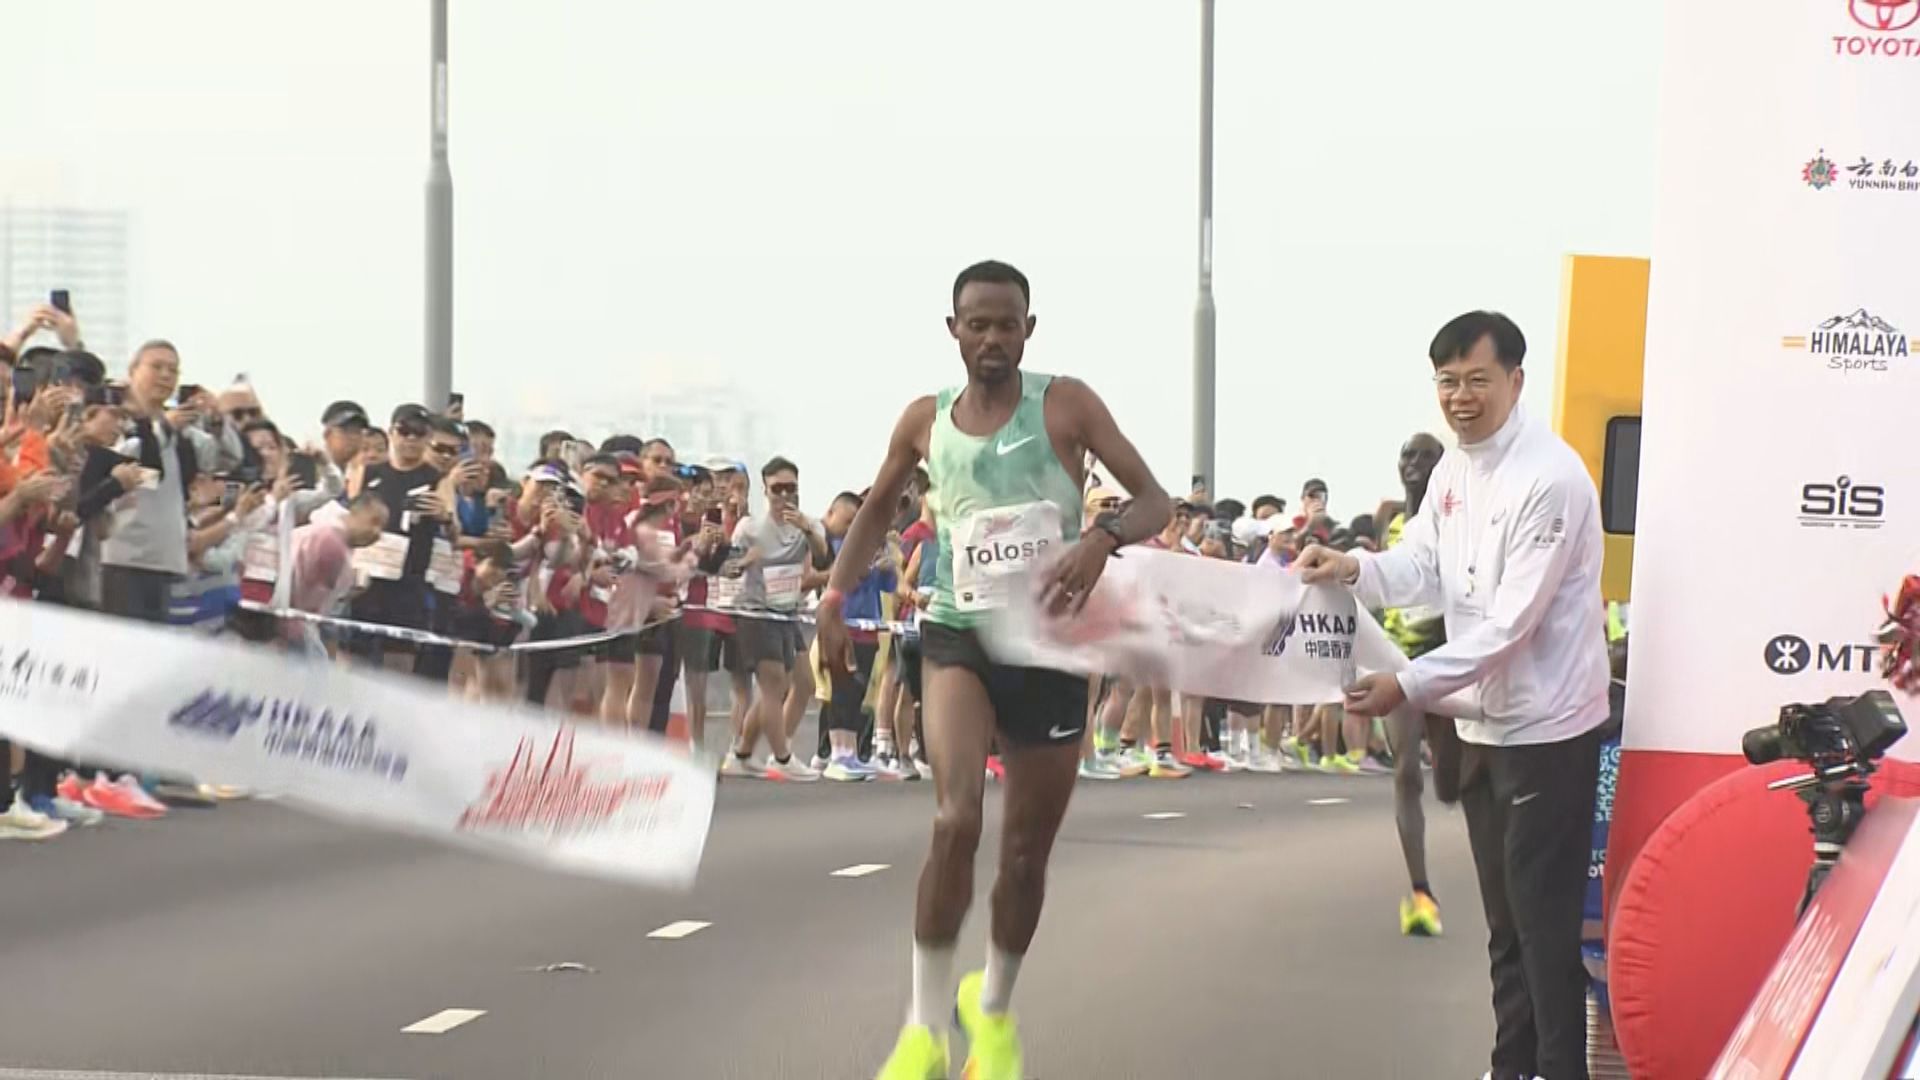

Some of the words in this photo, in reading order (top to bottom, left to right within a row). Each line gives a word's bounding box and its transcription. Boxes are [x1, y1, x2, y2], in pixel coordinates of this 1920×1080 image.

[1811, 331, 1908, 357] HIMALAYA
[1827, 356, 1888, 375] Sports
[1817, 643, 1878, 672] MT
